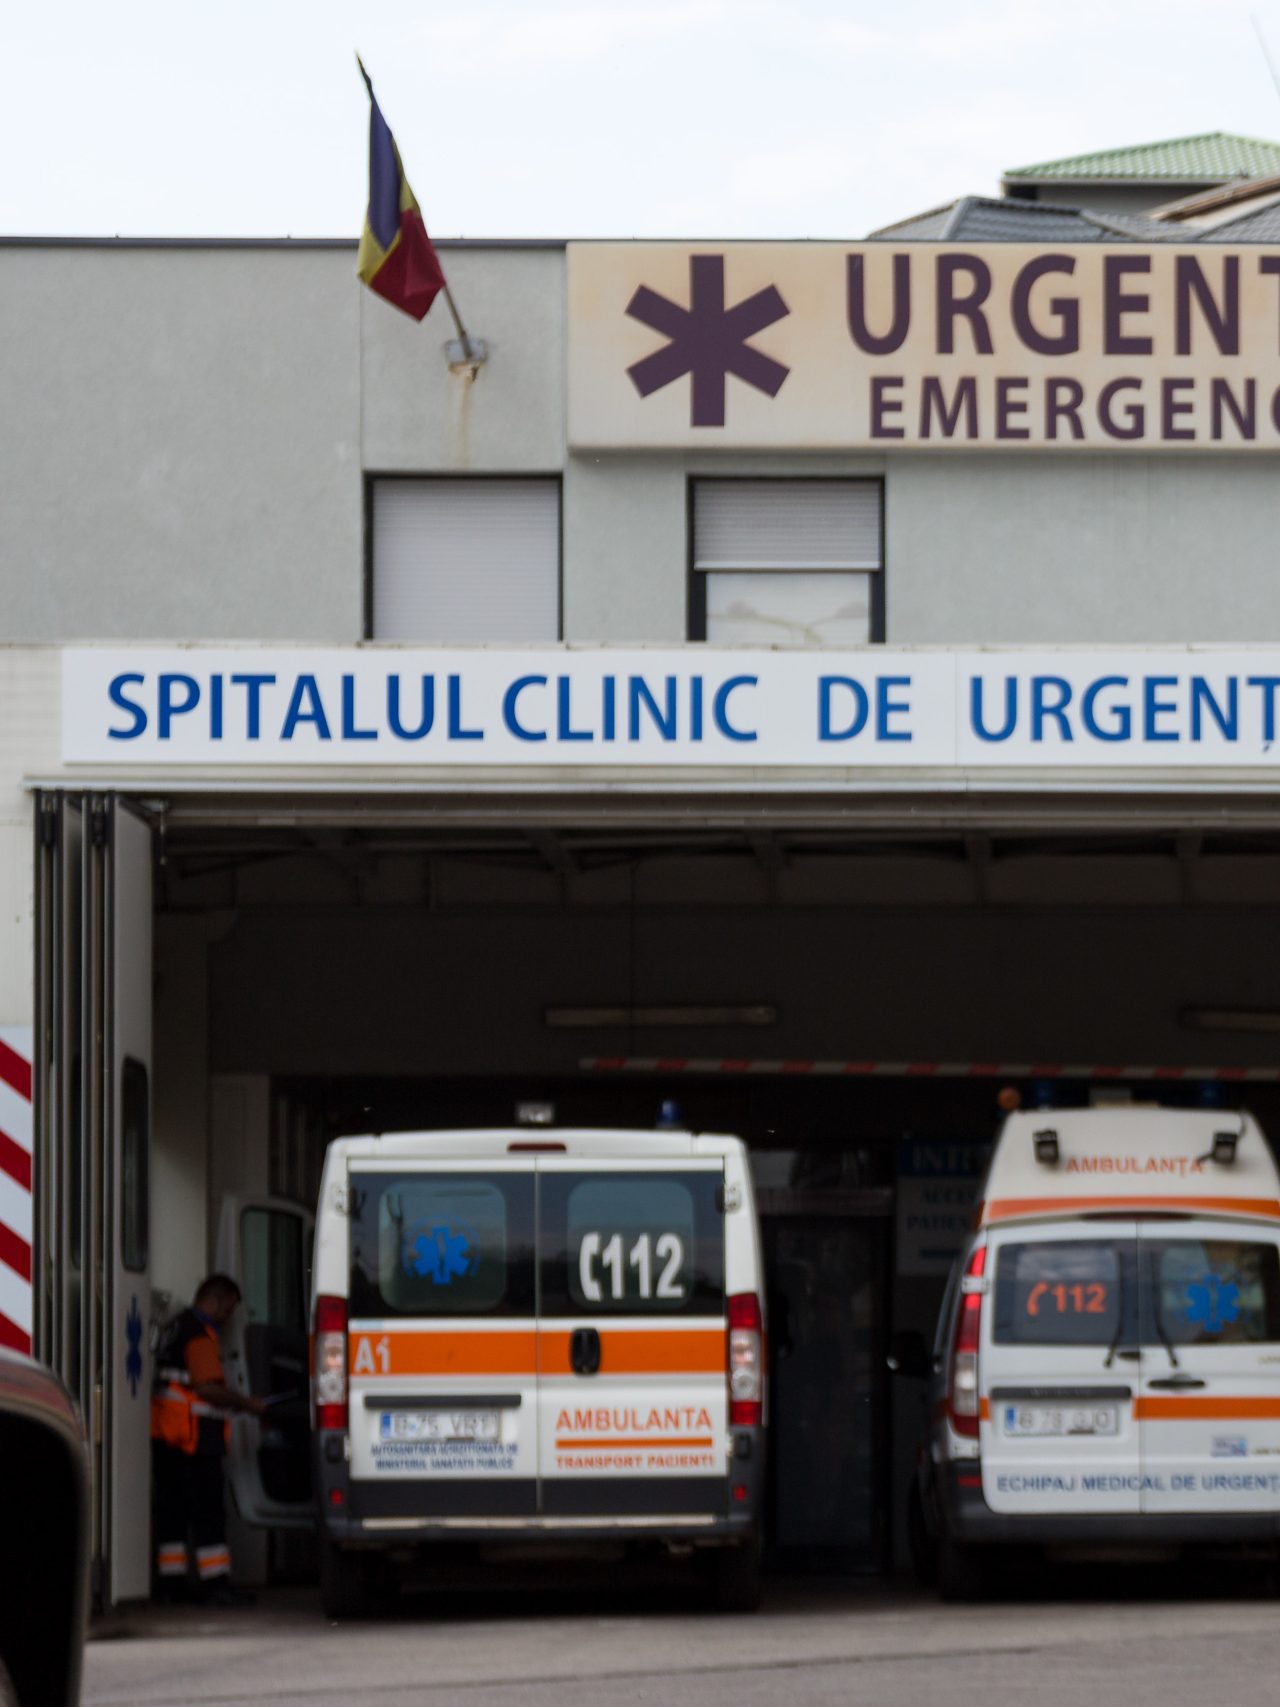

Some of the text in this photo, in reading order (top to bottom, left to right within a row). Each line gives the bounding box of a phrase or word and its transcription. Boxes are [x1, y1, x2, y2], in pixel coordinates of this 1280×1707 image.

[106, 673, 485, 743] SPITALUL
[501, 674, 759, 743] CLINIC
[816, 675, 913, 743] DE
[601, 1232, 685, 1299] 112
[1050, 1283, 1106, 1313] 112
[354, 1336, 392, 1374] A1
[556, 1455, 642, 1469] TRANSPORT
[997, 1475, 1075, 1492] ECHIPAJ
[1081, 1474, 1163, 1491] MEDICAL
[1170, 1473, 1196, 1491] DE
